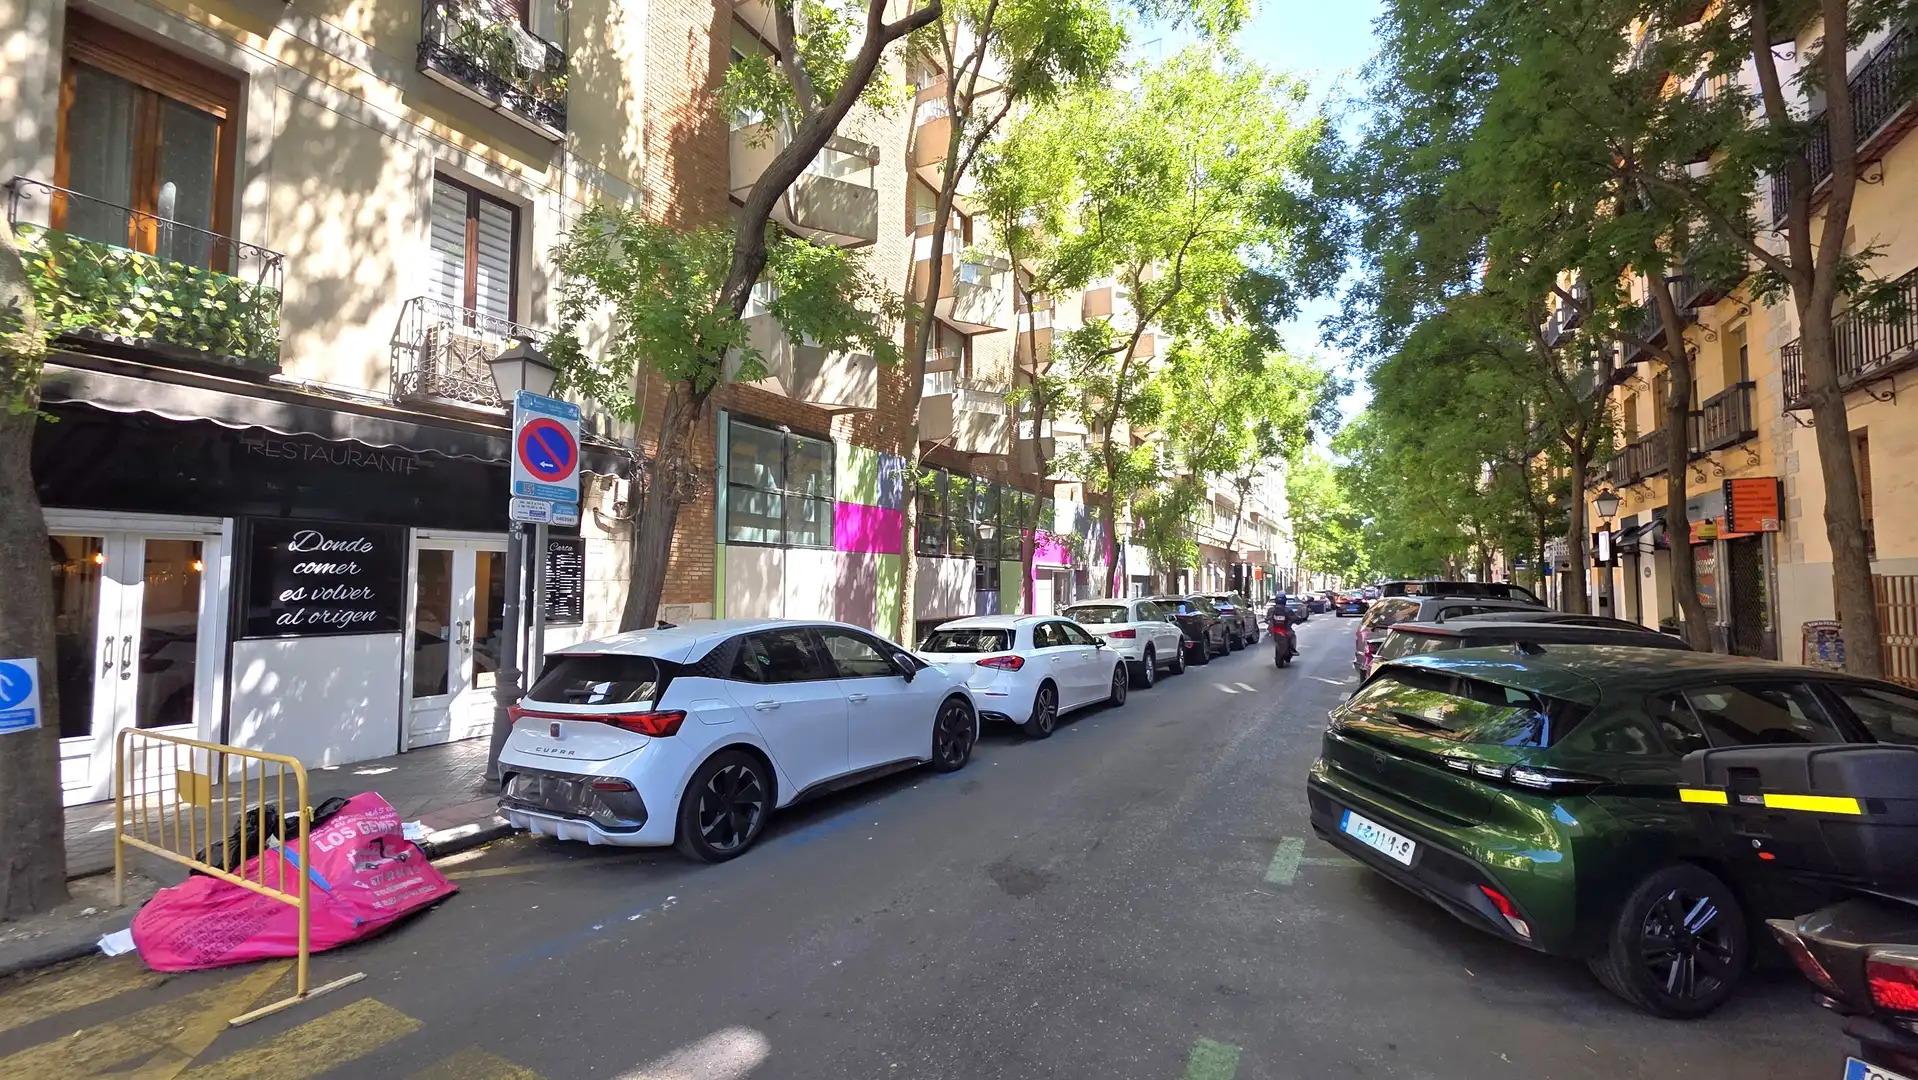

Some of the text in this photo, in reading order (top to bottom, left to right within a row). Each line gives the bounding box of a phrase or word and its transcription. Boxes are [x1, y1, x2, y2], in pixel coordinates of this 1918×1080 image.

[247, 439, 419, 475] RESTAURANTE
[287, 529, 374, 553] Donde
[549, 541, 574, 552] Carta
[292, 561, 362, 575] comer
[279, 584, 376, 602] es volver
[275, 607, 378, 629] al origen
[535, 746, 576, 757] CUPRA
[314, 826, 357, 853] LOS
